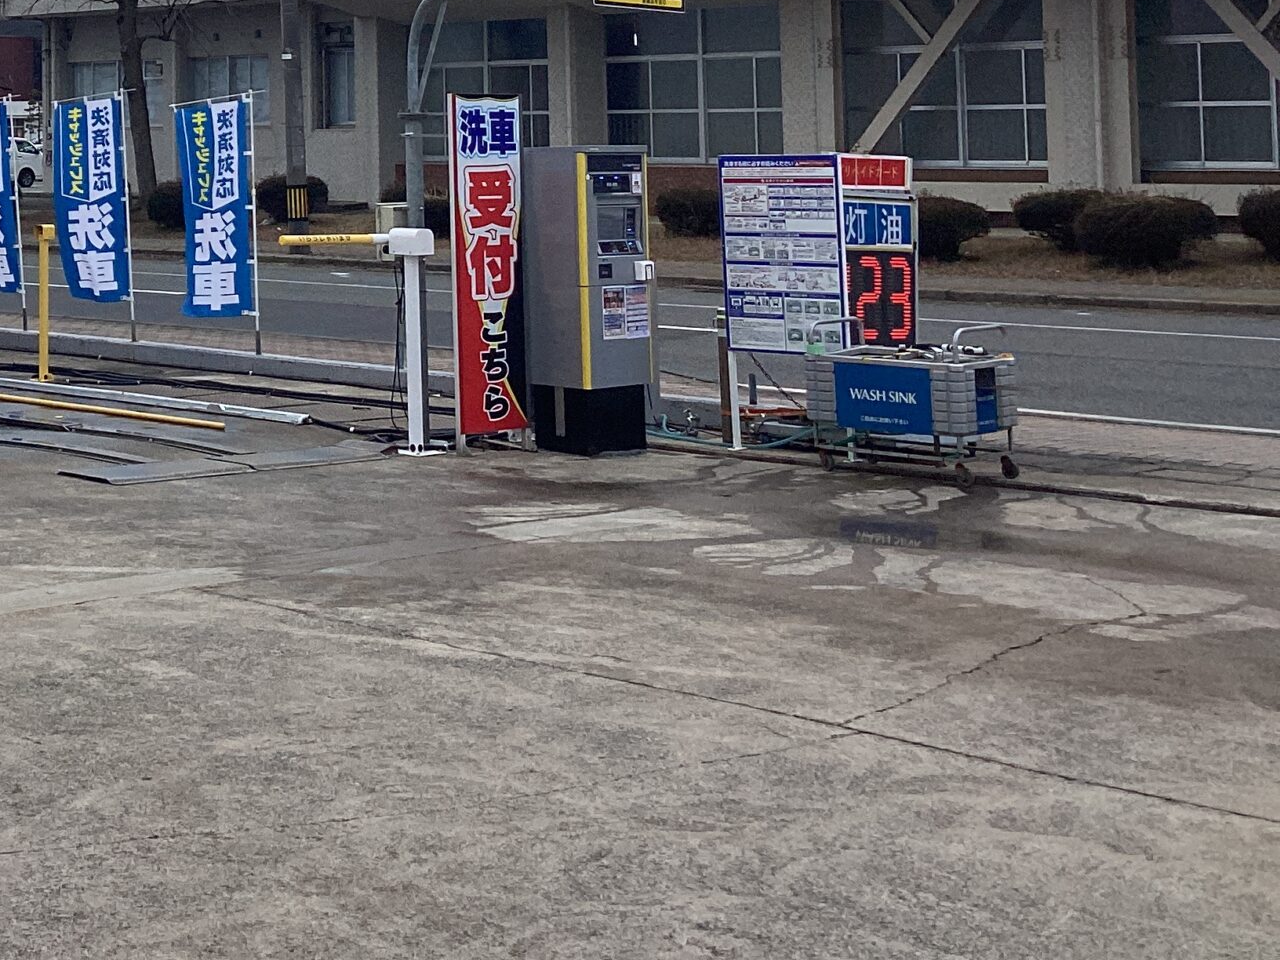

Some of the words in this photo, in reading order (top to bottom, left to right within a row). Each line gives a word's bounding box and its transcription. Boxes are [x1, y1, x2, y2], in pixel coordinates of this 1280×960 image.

[459, 108, 517, 155] 洗車
[466, 169, 515, 296] 受付
[846, 205, 902, 245] 灯油
[846, 256, 911, 339] 23
[481, 311, 510, 421] こちら
[849, 387, 886, 402] WASH
[889, 390, 917, 405] SINK
